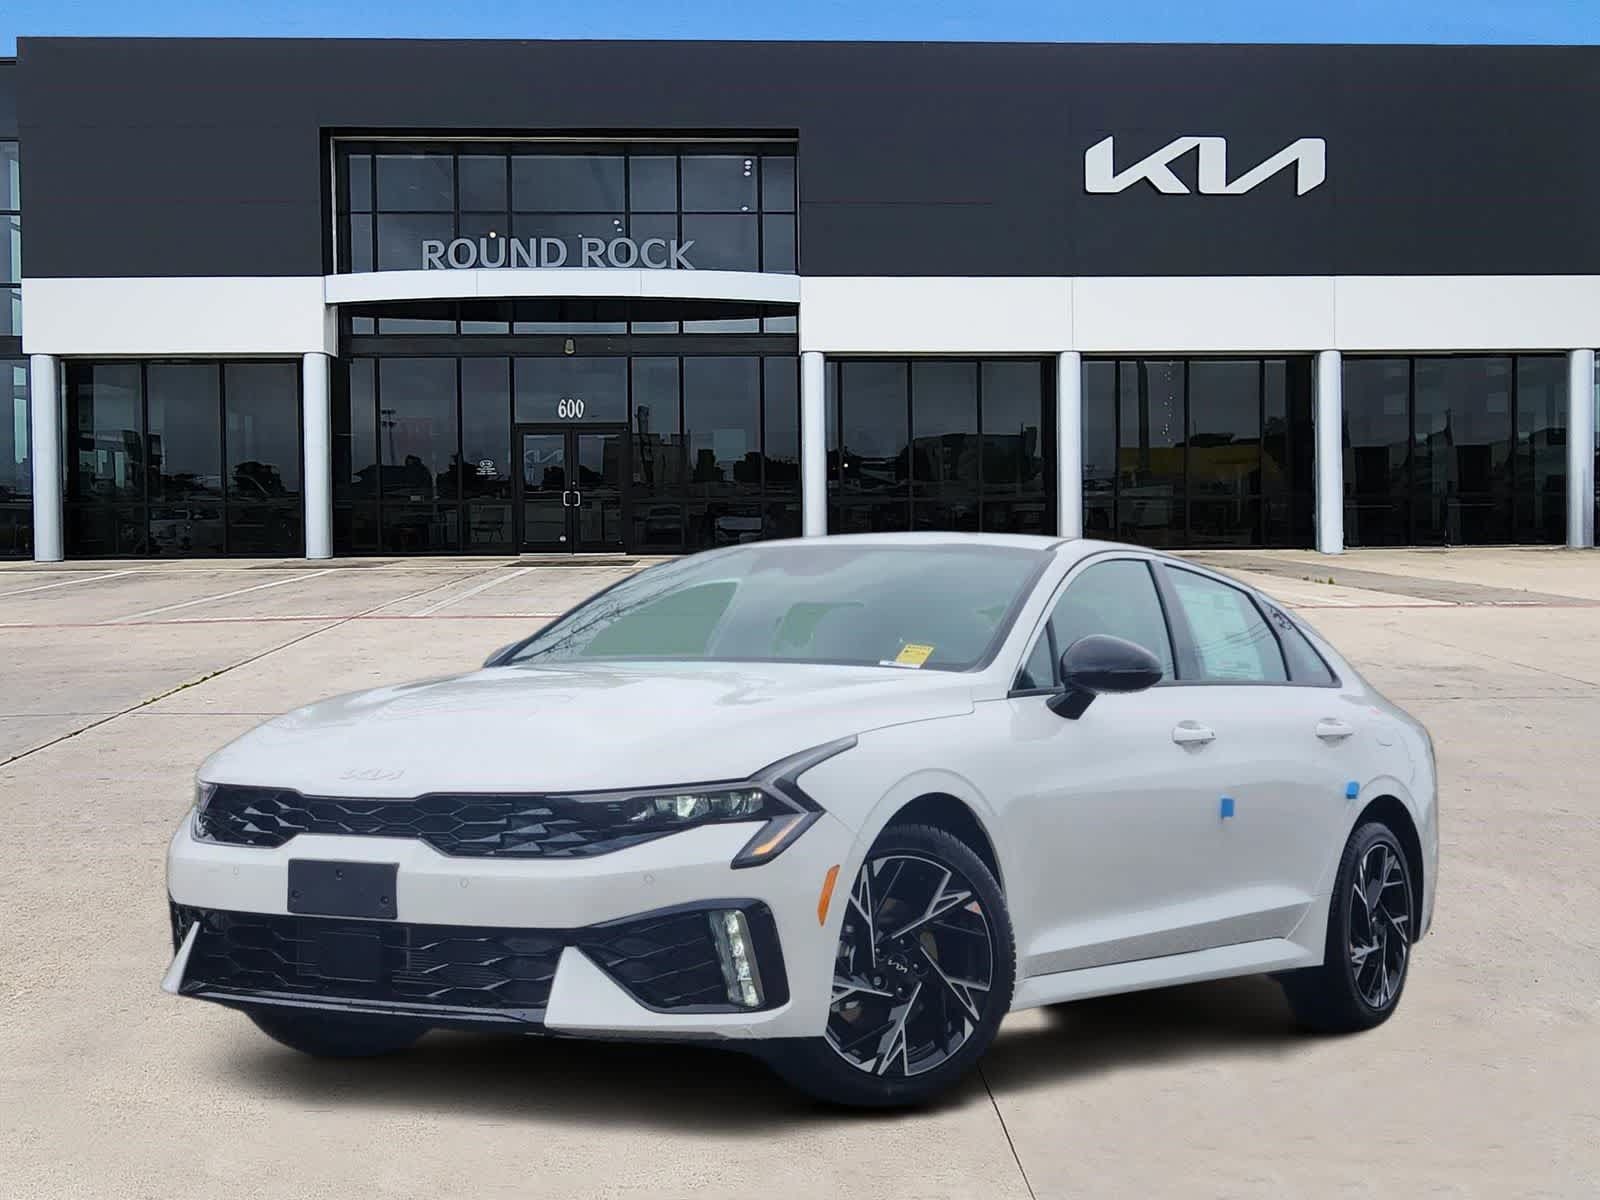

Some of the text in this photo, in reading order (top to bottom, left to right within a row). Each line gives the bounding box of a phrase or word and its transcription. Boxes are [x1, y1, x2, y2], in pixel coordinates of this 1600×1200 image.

[1085, 136, 1326, 196] KIA
[422, 238, 695, 269] ROUND ROCK
[558, 399, 584, 418] 600
